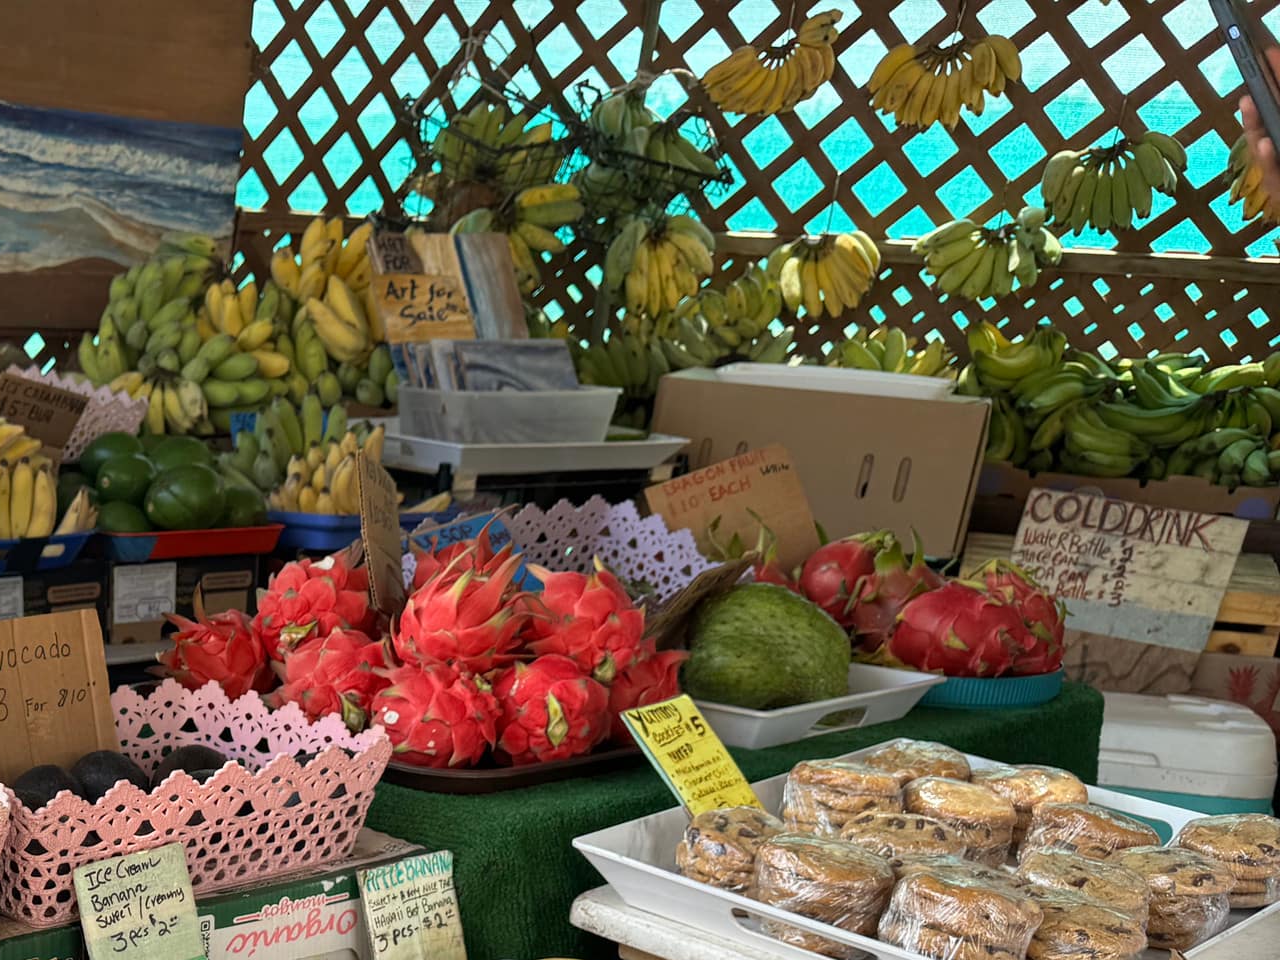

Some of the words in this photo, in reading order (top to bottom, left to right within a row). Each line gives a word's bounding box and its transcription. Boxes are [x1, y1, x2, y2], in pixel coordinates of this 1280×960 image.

[385, 279, 420, 300] Art
[707, 476, 753, 502] EACH
[628, 702, 683, 738] Yummy
[225, 908, 358, 958] Organic
